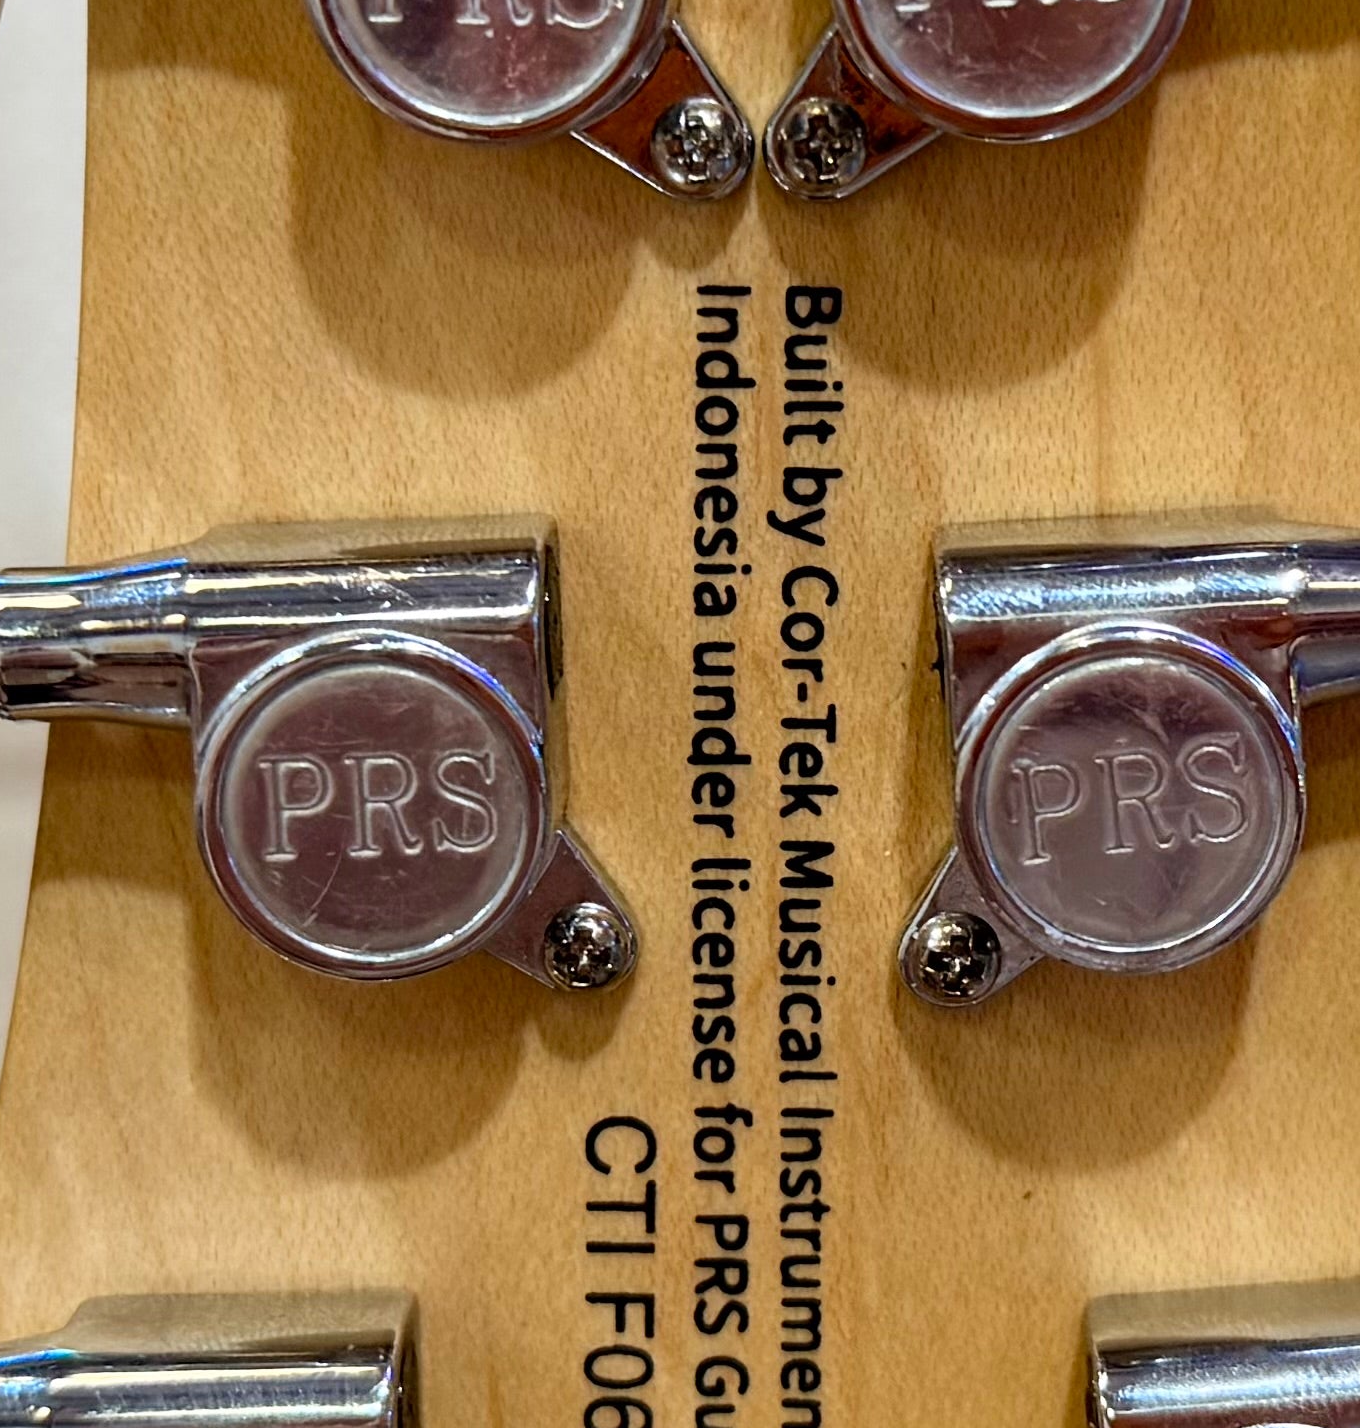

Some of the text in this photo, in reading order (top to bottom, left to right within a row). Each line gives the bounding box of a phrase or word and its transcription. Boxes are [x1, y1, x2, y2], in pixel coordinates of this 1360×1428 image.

[782, 284, 844, 447] Built
[693, 283, 757, 618] Indonesia
[766, 466, 843, 547] by
[687, 640, 753, 840] under
[778, 564, 840, 819] Cor-Tek
[257, 750, 500, 862] PRS
[1010, 732, 1248, 865] PRS
[690, 857, 752, 1085] license
[777, 839, 838, 1085] Musical
[584, 1115, 658, 1256] CTI
[692, 1101, 754, 1196] for
[692, 1213, 751, 1337] PRS
